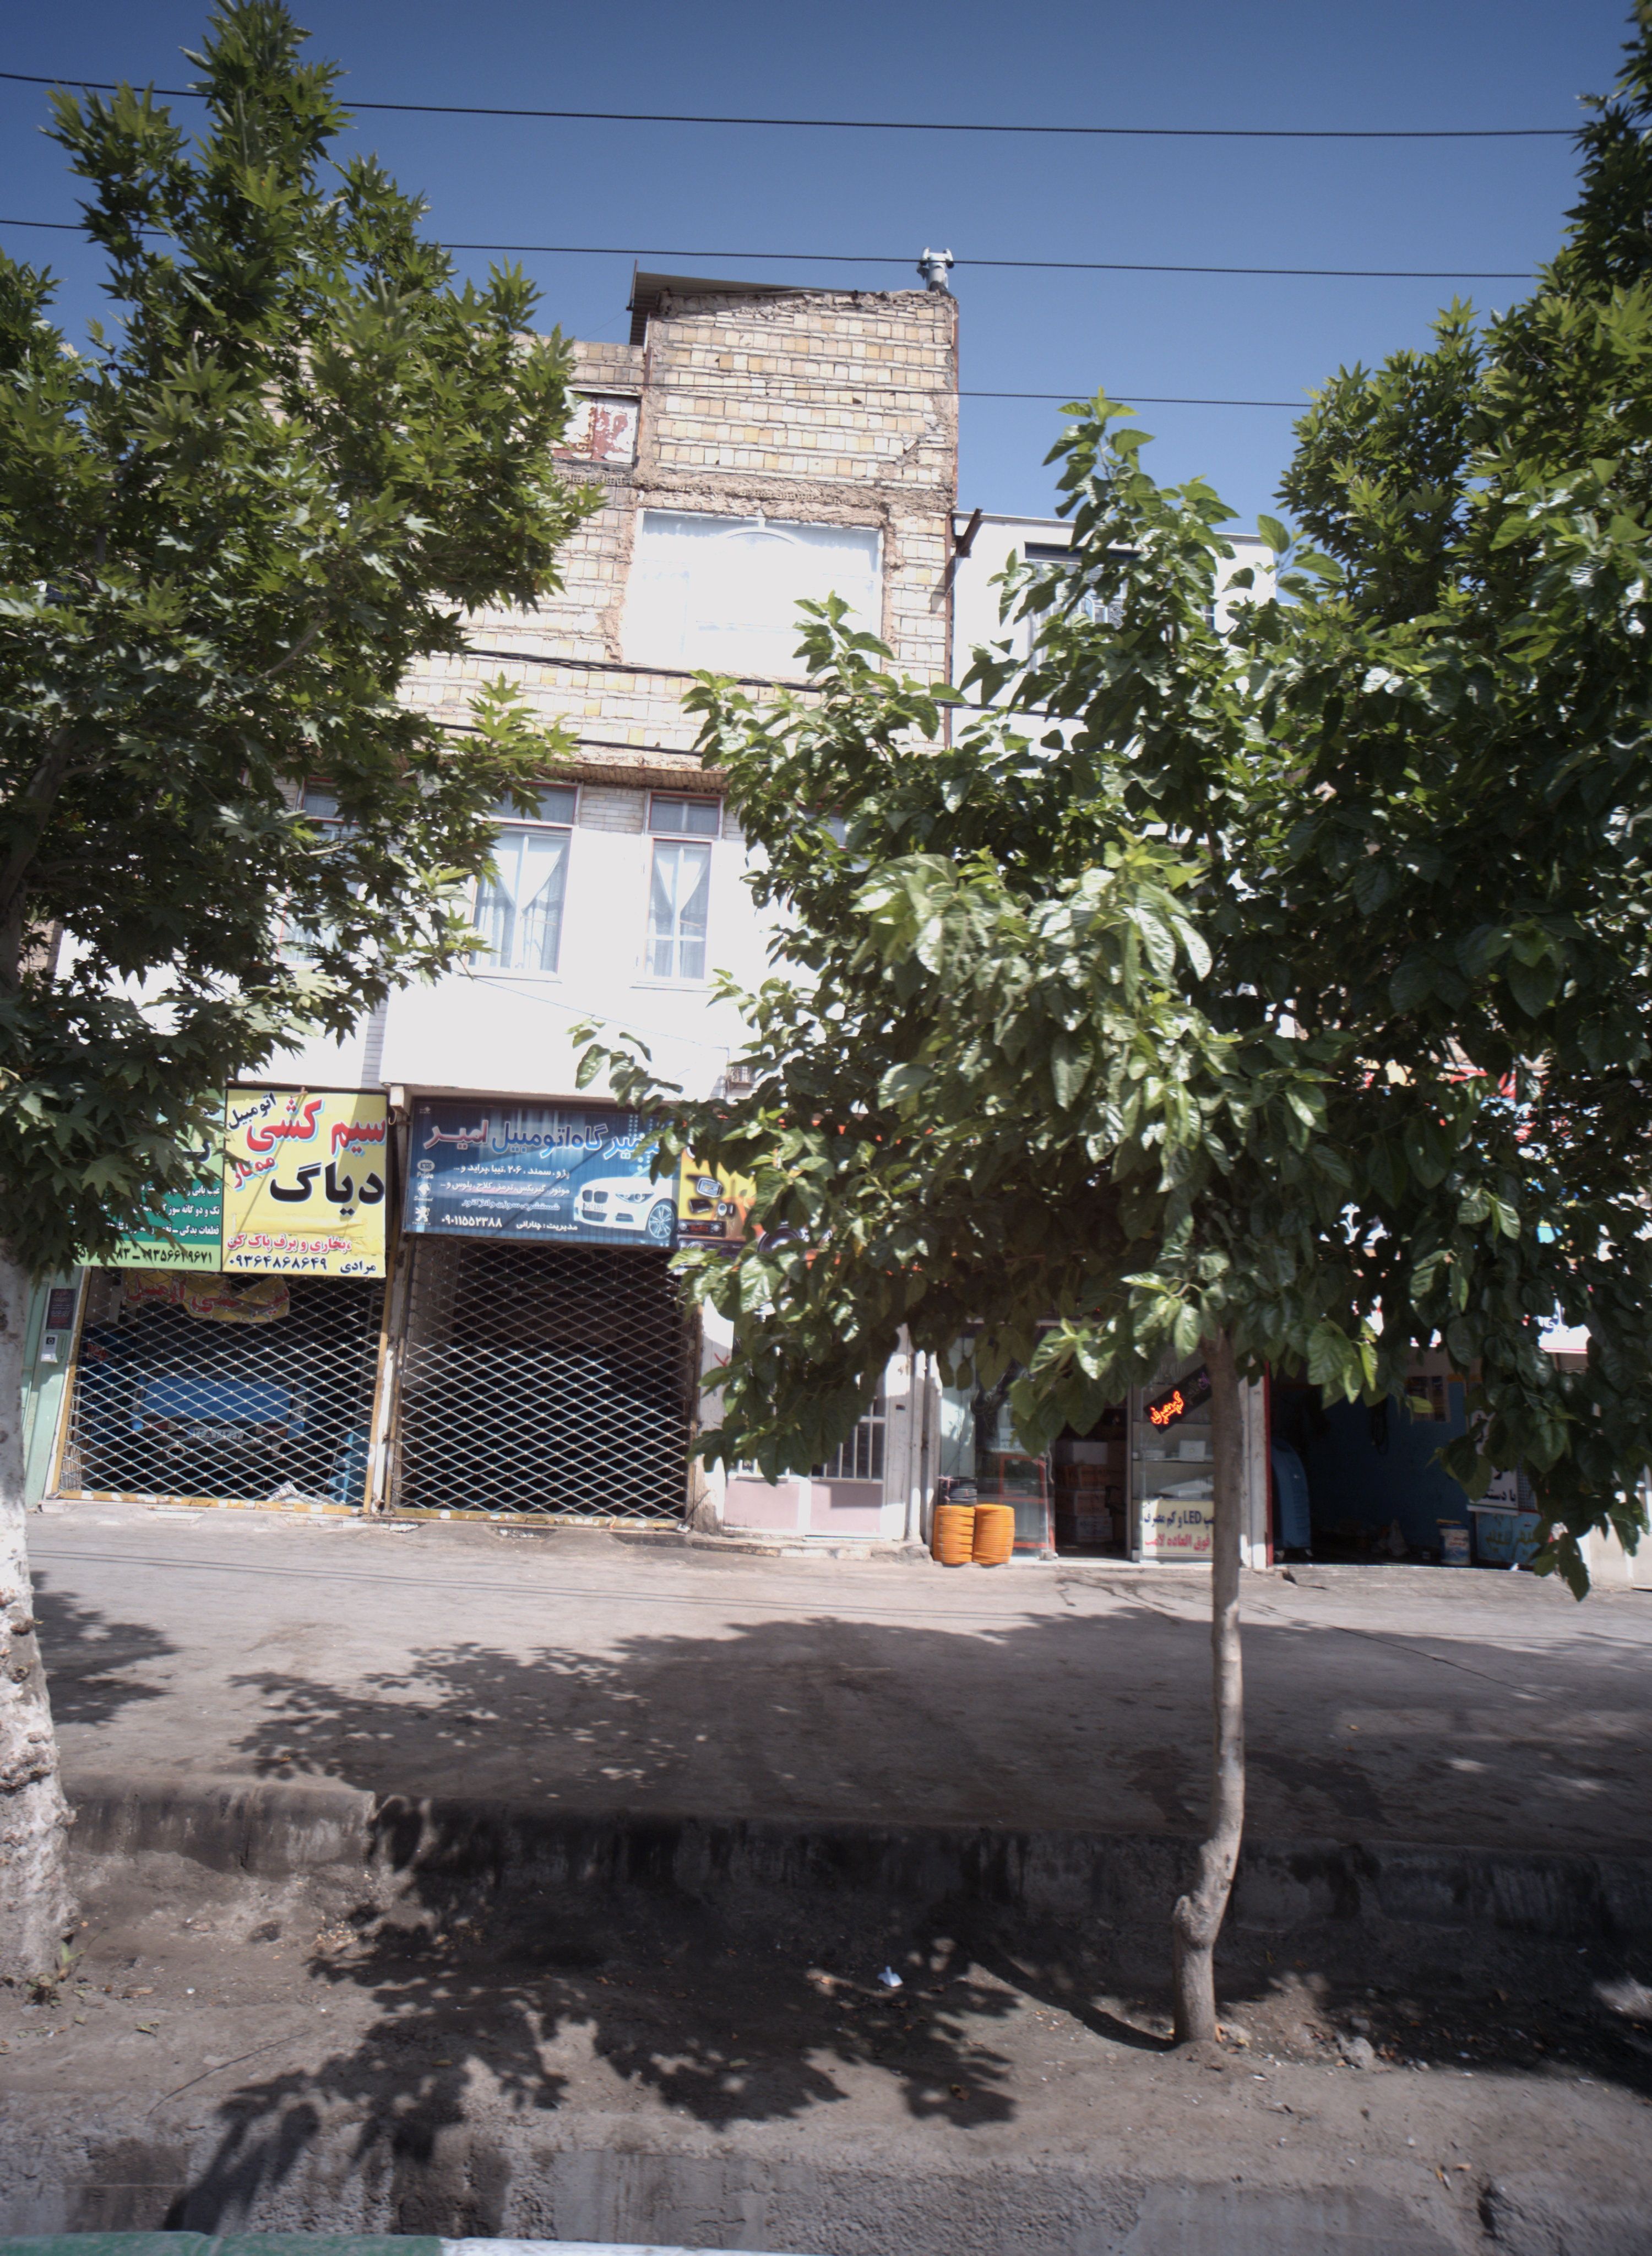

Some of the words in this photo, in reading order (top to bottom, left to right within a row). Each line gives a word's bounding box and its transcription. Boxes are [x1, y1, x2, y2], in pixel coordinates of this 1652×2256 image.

[229, 1092, 276, 1129] اتومبیل
[247, 1099, 323, 1152] کشی
[332, 1119, 385, 1156] سیم
[423, 1119, 489, 1151] امیر
[492, 1121, 572, 1159] اتومبیل
[572, 1124, 608, 1151] گاه
[460, 1165, 466, 1173] و
[507, 1165, 522, 1174] ۲۰۶
[270, 1162, 385, 1216] دیاگ
[446, 1181, 451, 1189] و
[168, 1205, 180, 1216] سوز
[195, 1207, 203, 1217] دو
[204, 1209, 208, 1217] و
[209, 1206, 220, 1215] تک
[180, 1225, 197, 1237] یدکی
[198, 1225, 220, 1235] قطعات
[515, 1220, 542, 1230] چنارانی
[227, 1234, 246, 1249] کن
[248, 1234, 271, 1251] پاک
[275, 1234, 298, 1251] برف
[301, 1241, 307, 1252] و
[229, 1254, 328, 1271] ۰۹۳۶۴۸۶۸۶۴۹
[340, 1260, 377, 1275] مرادی
[1177, 1516, 1182, 1529] و
[1183, 1510, 1202, 1525] LED
[1167, 1533, 1192, 1547] العاده
[1193, 1533, 1211, 1551] فوق
